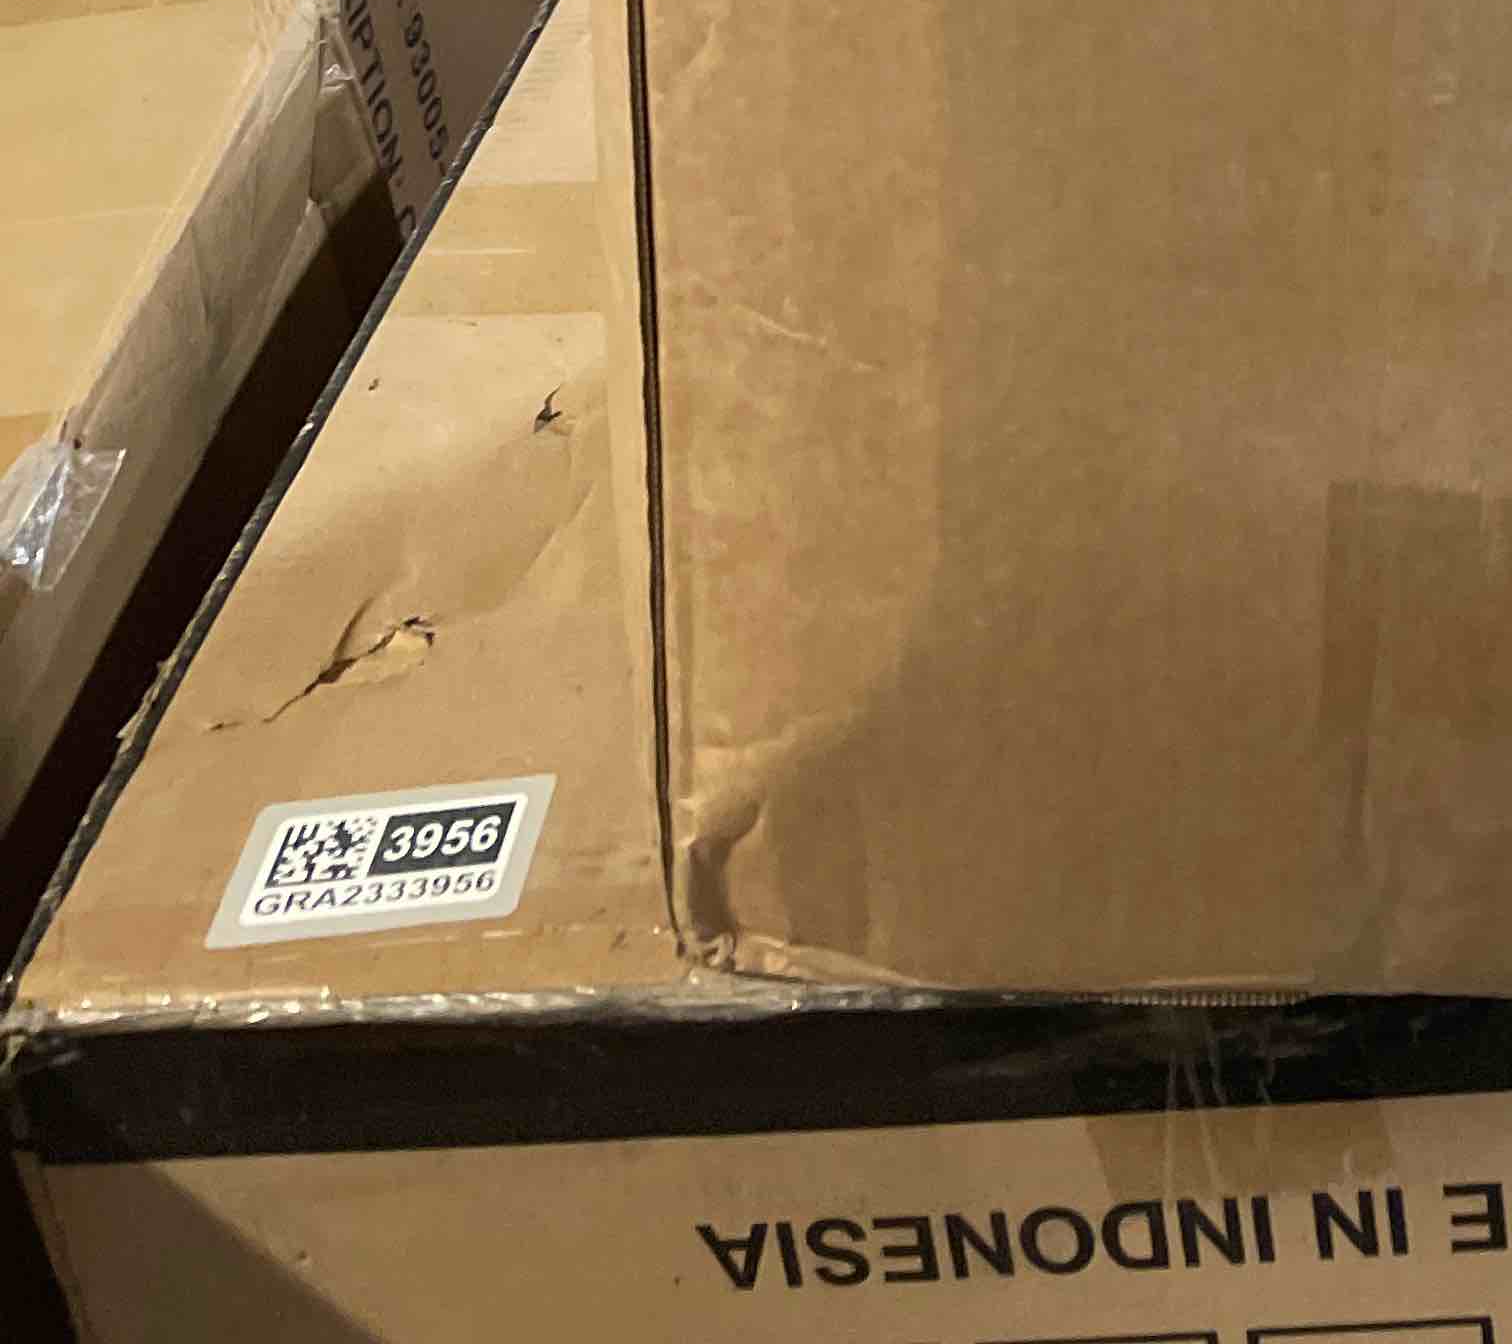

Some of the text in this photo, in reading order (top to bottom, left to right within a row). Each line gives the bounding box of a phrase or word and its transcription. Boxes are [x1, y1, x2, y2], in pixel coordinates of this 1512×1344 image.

[381, 815, 503, 864] 3956
[253, 869, 498, 917] GRA2333956
[693, 1194, 1277, 1289] INDONESIA
[1313, 1184, 1411, 1262] IN
